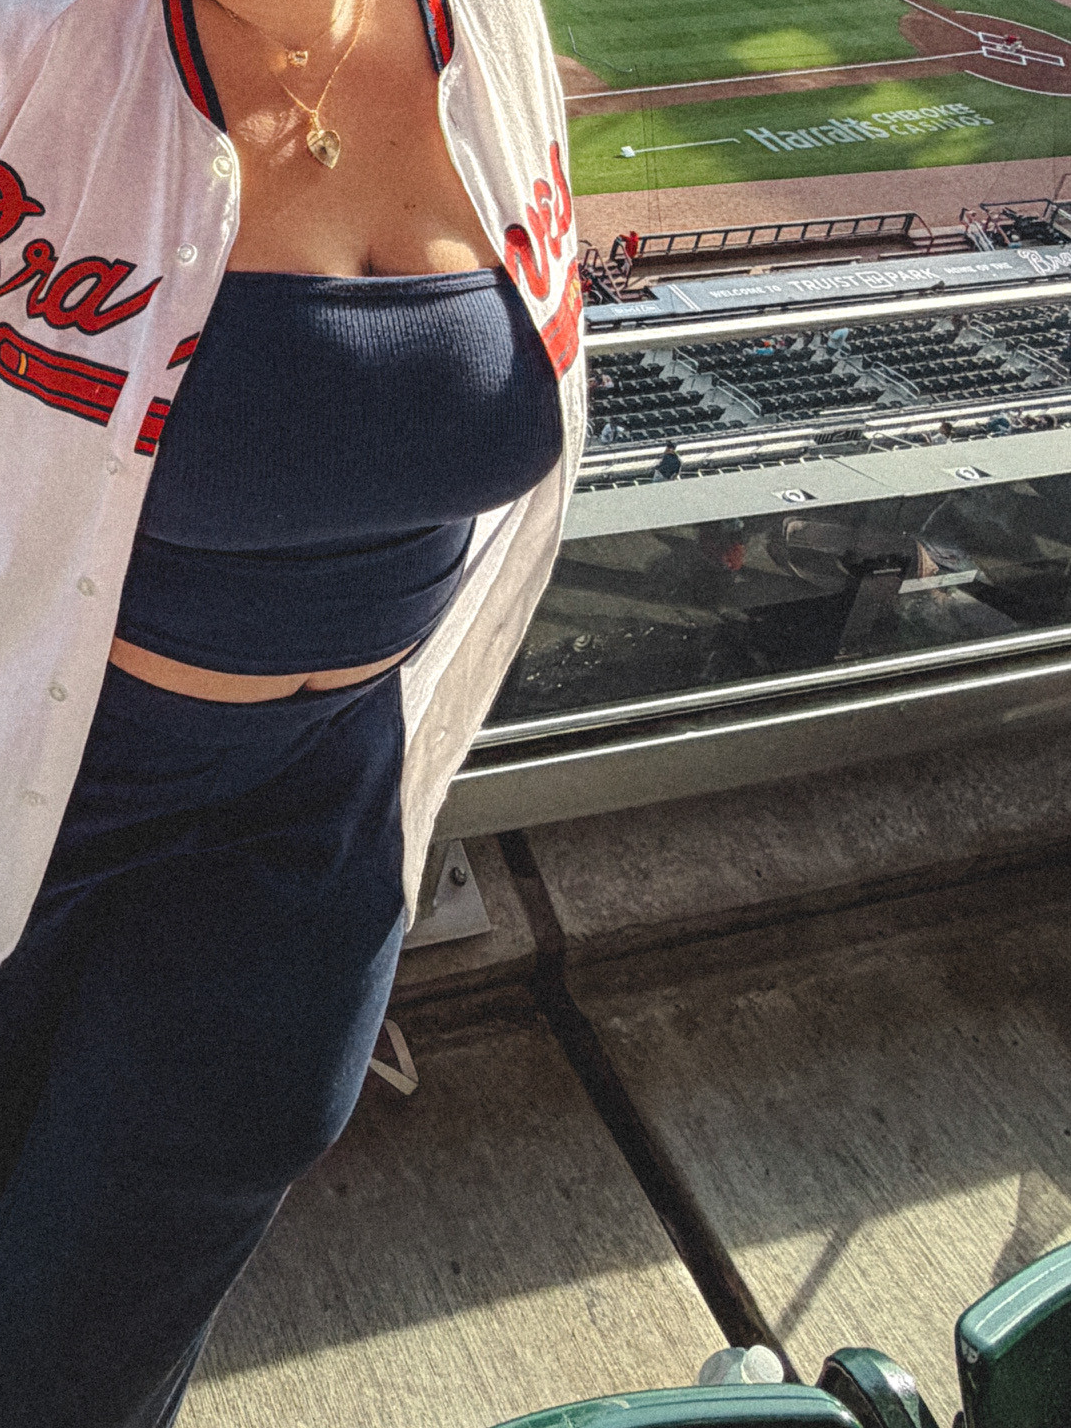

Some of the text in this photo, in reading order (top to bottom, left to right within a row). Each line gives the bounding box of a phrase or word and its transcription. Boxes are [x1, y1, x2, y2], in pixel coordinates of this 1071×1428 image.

[743, 102, 977, 152] Harrah's CHEROKEE
[889, 113, 995, 136] CASINOS
[710, 287, 766, 298] WELCOME
[767, 285, 782, 293] TO
[787, 275, 860, 292] TRUIST
[886, 267, 941, 282] PARK
